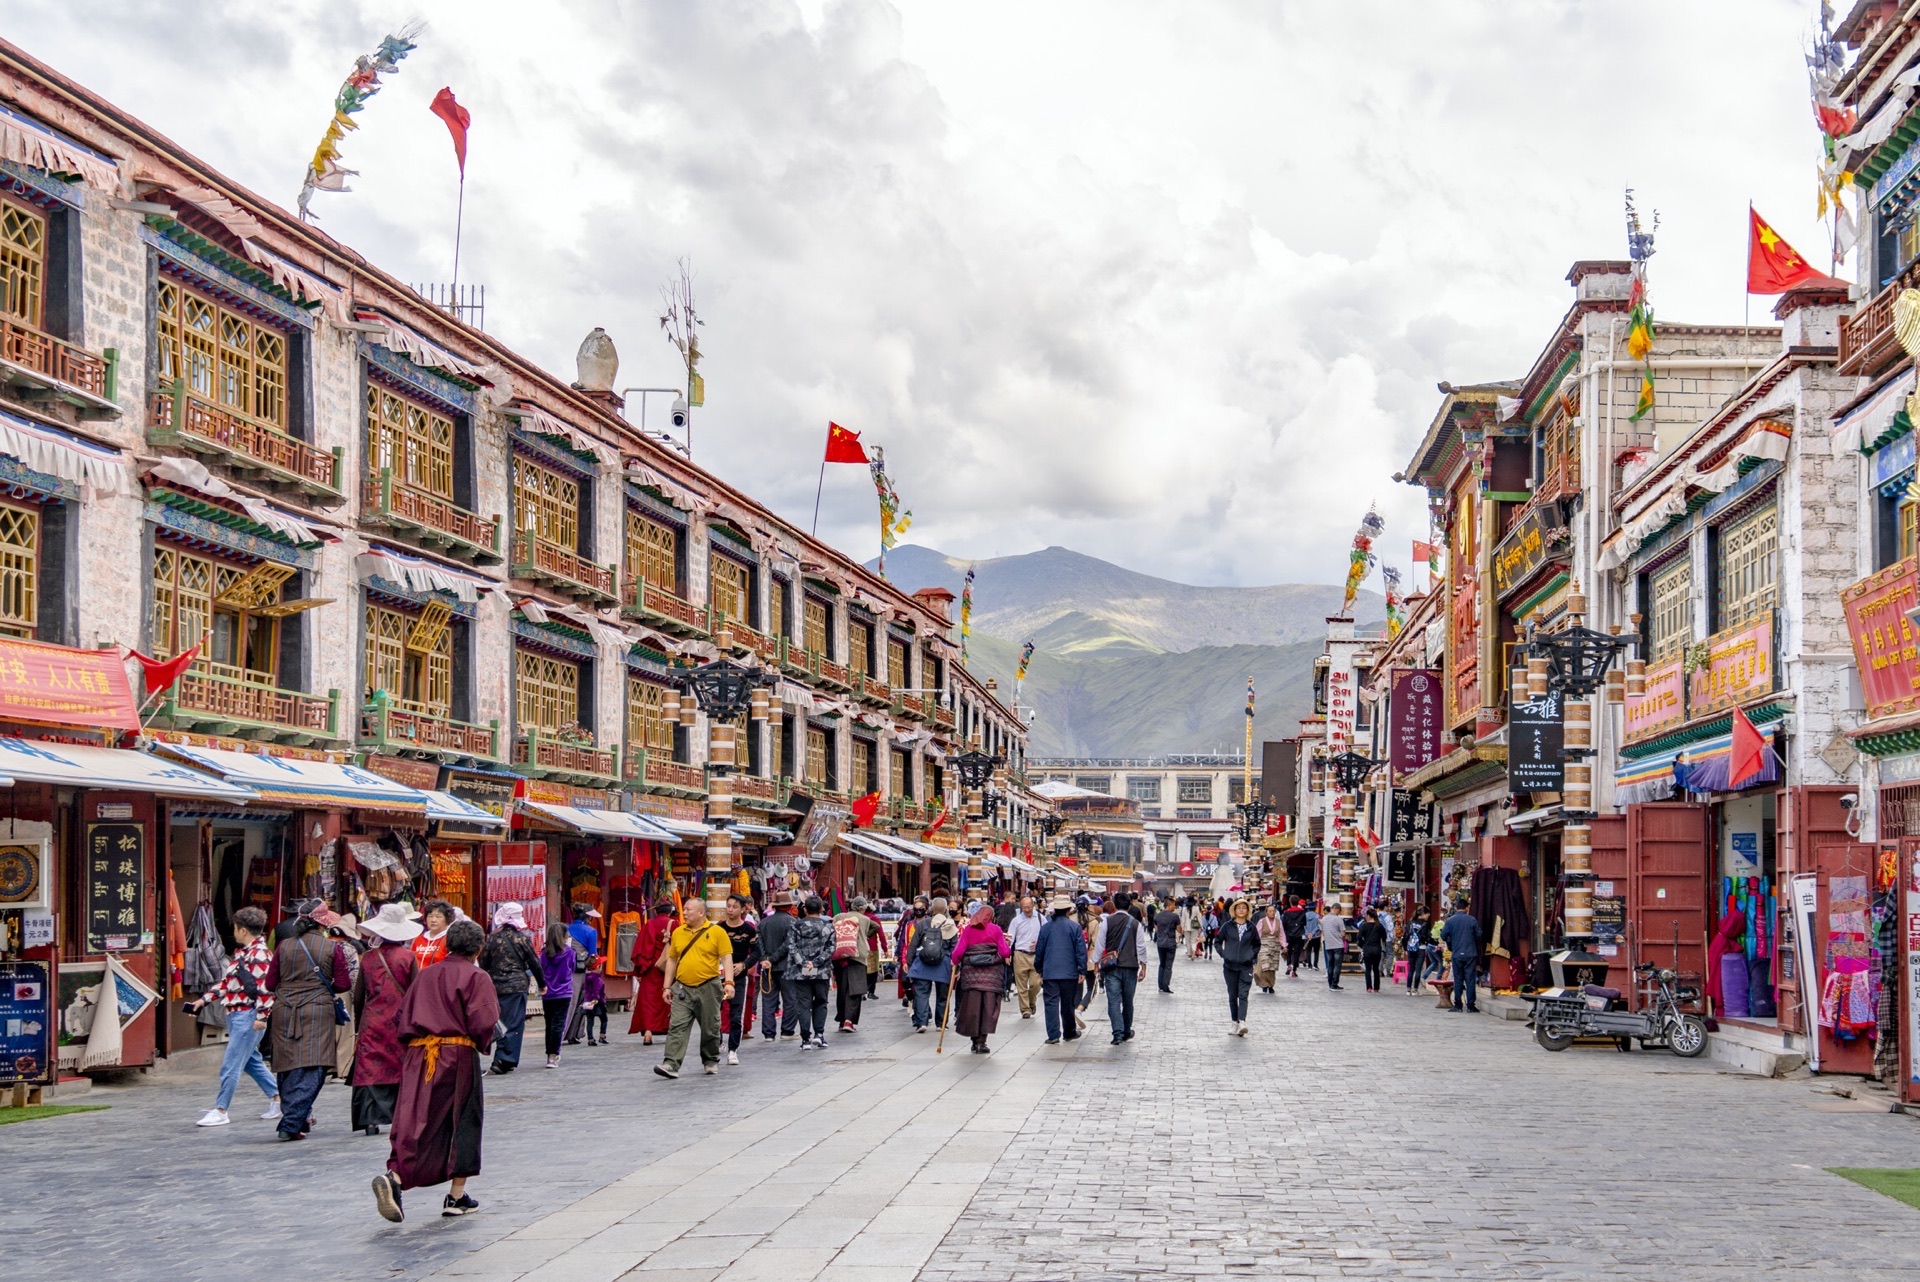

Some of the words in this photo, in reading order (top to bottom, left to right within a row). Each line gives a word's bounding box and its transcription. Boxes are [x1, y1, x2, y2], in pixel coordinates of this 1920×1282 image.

[1890, 651, 1902, 665] GIFT
[1903, 645, 1917, 661] SHOP
[1422, 694, 1432, 763] 藏文化体验馆
[1533, 729, 1541, 760] 私人定制
[117, 835, 137, 927] 松珠博雅
[25, 919, 52, 928] 牛骨项链
